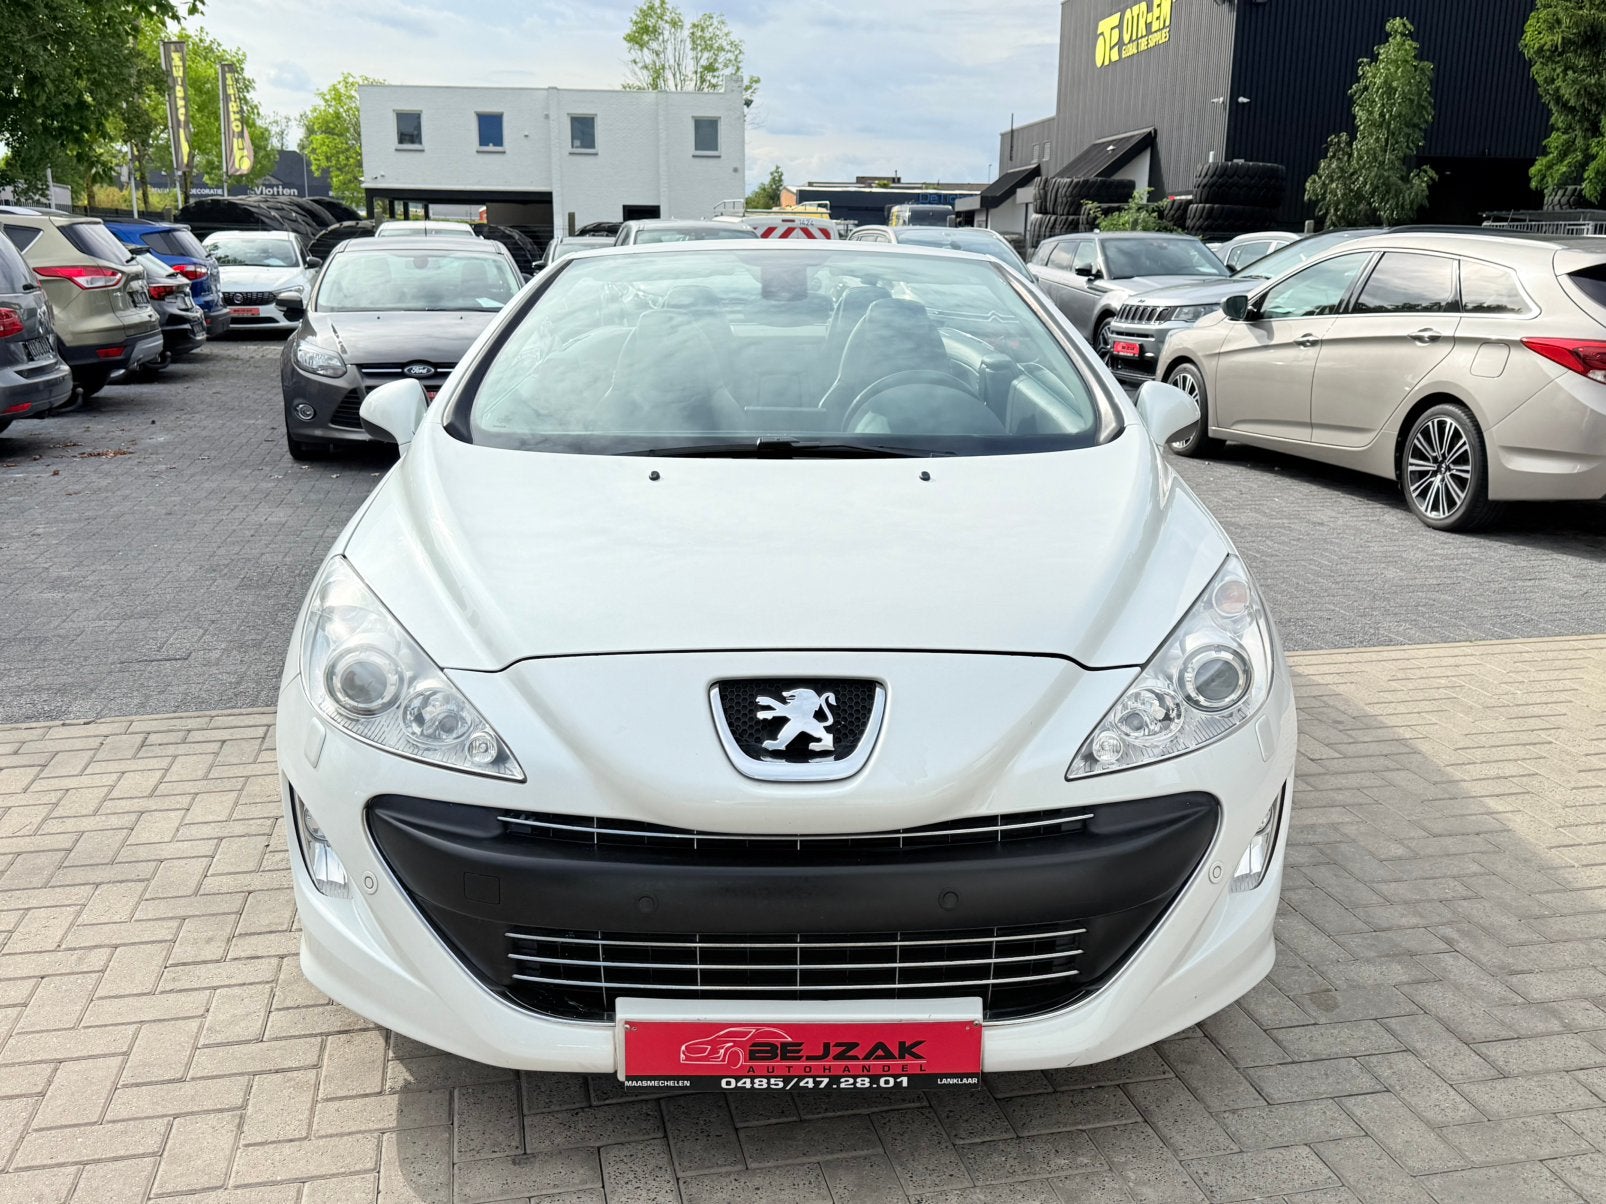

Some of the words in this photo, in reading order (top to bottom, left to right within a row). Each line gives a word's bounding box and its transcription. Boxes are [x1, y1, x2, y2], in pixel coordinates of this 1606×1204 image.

[1123, 0, 1171, 45] OTR-EM
[255, 185, 298, 196] Vlotten
[411, 366, 428, 374] Ford
[749, 1040, 926, 1061] BEJZAK
[747, 1064, 926, 1074] AUTOHANDEL
[721, 1077, 908, 1090] 0485/47.28.01
